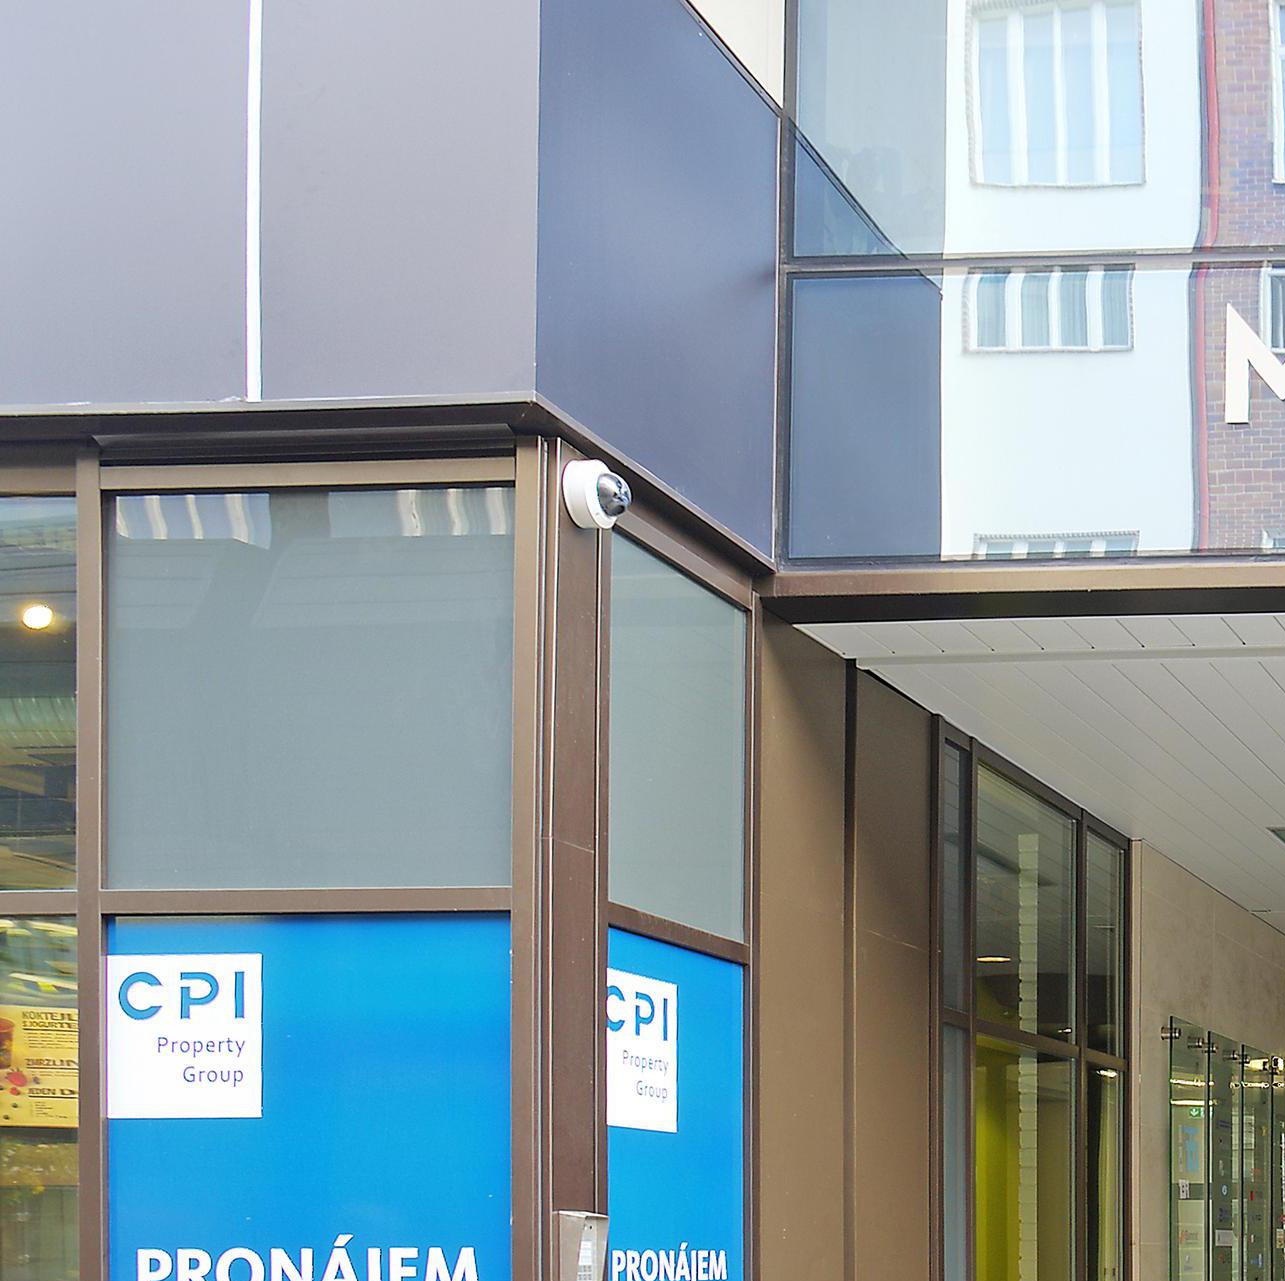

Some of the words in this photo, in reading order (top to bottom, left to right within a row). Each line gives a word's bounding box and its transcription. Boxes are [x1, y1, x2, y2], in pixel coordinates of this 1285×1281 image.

[118, 971, 245, 1021] CPI
[606, 985, 668, 1041] CPI
[157, 1036, 246, 1058] Property
[622, 1049, 669, 1076] Property
[183, 1065, 244, 1088] Group
[636, 1080, 668, 1103] Group
